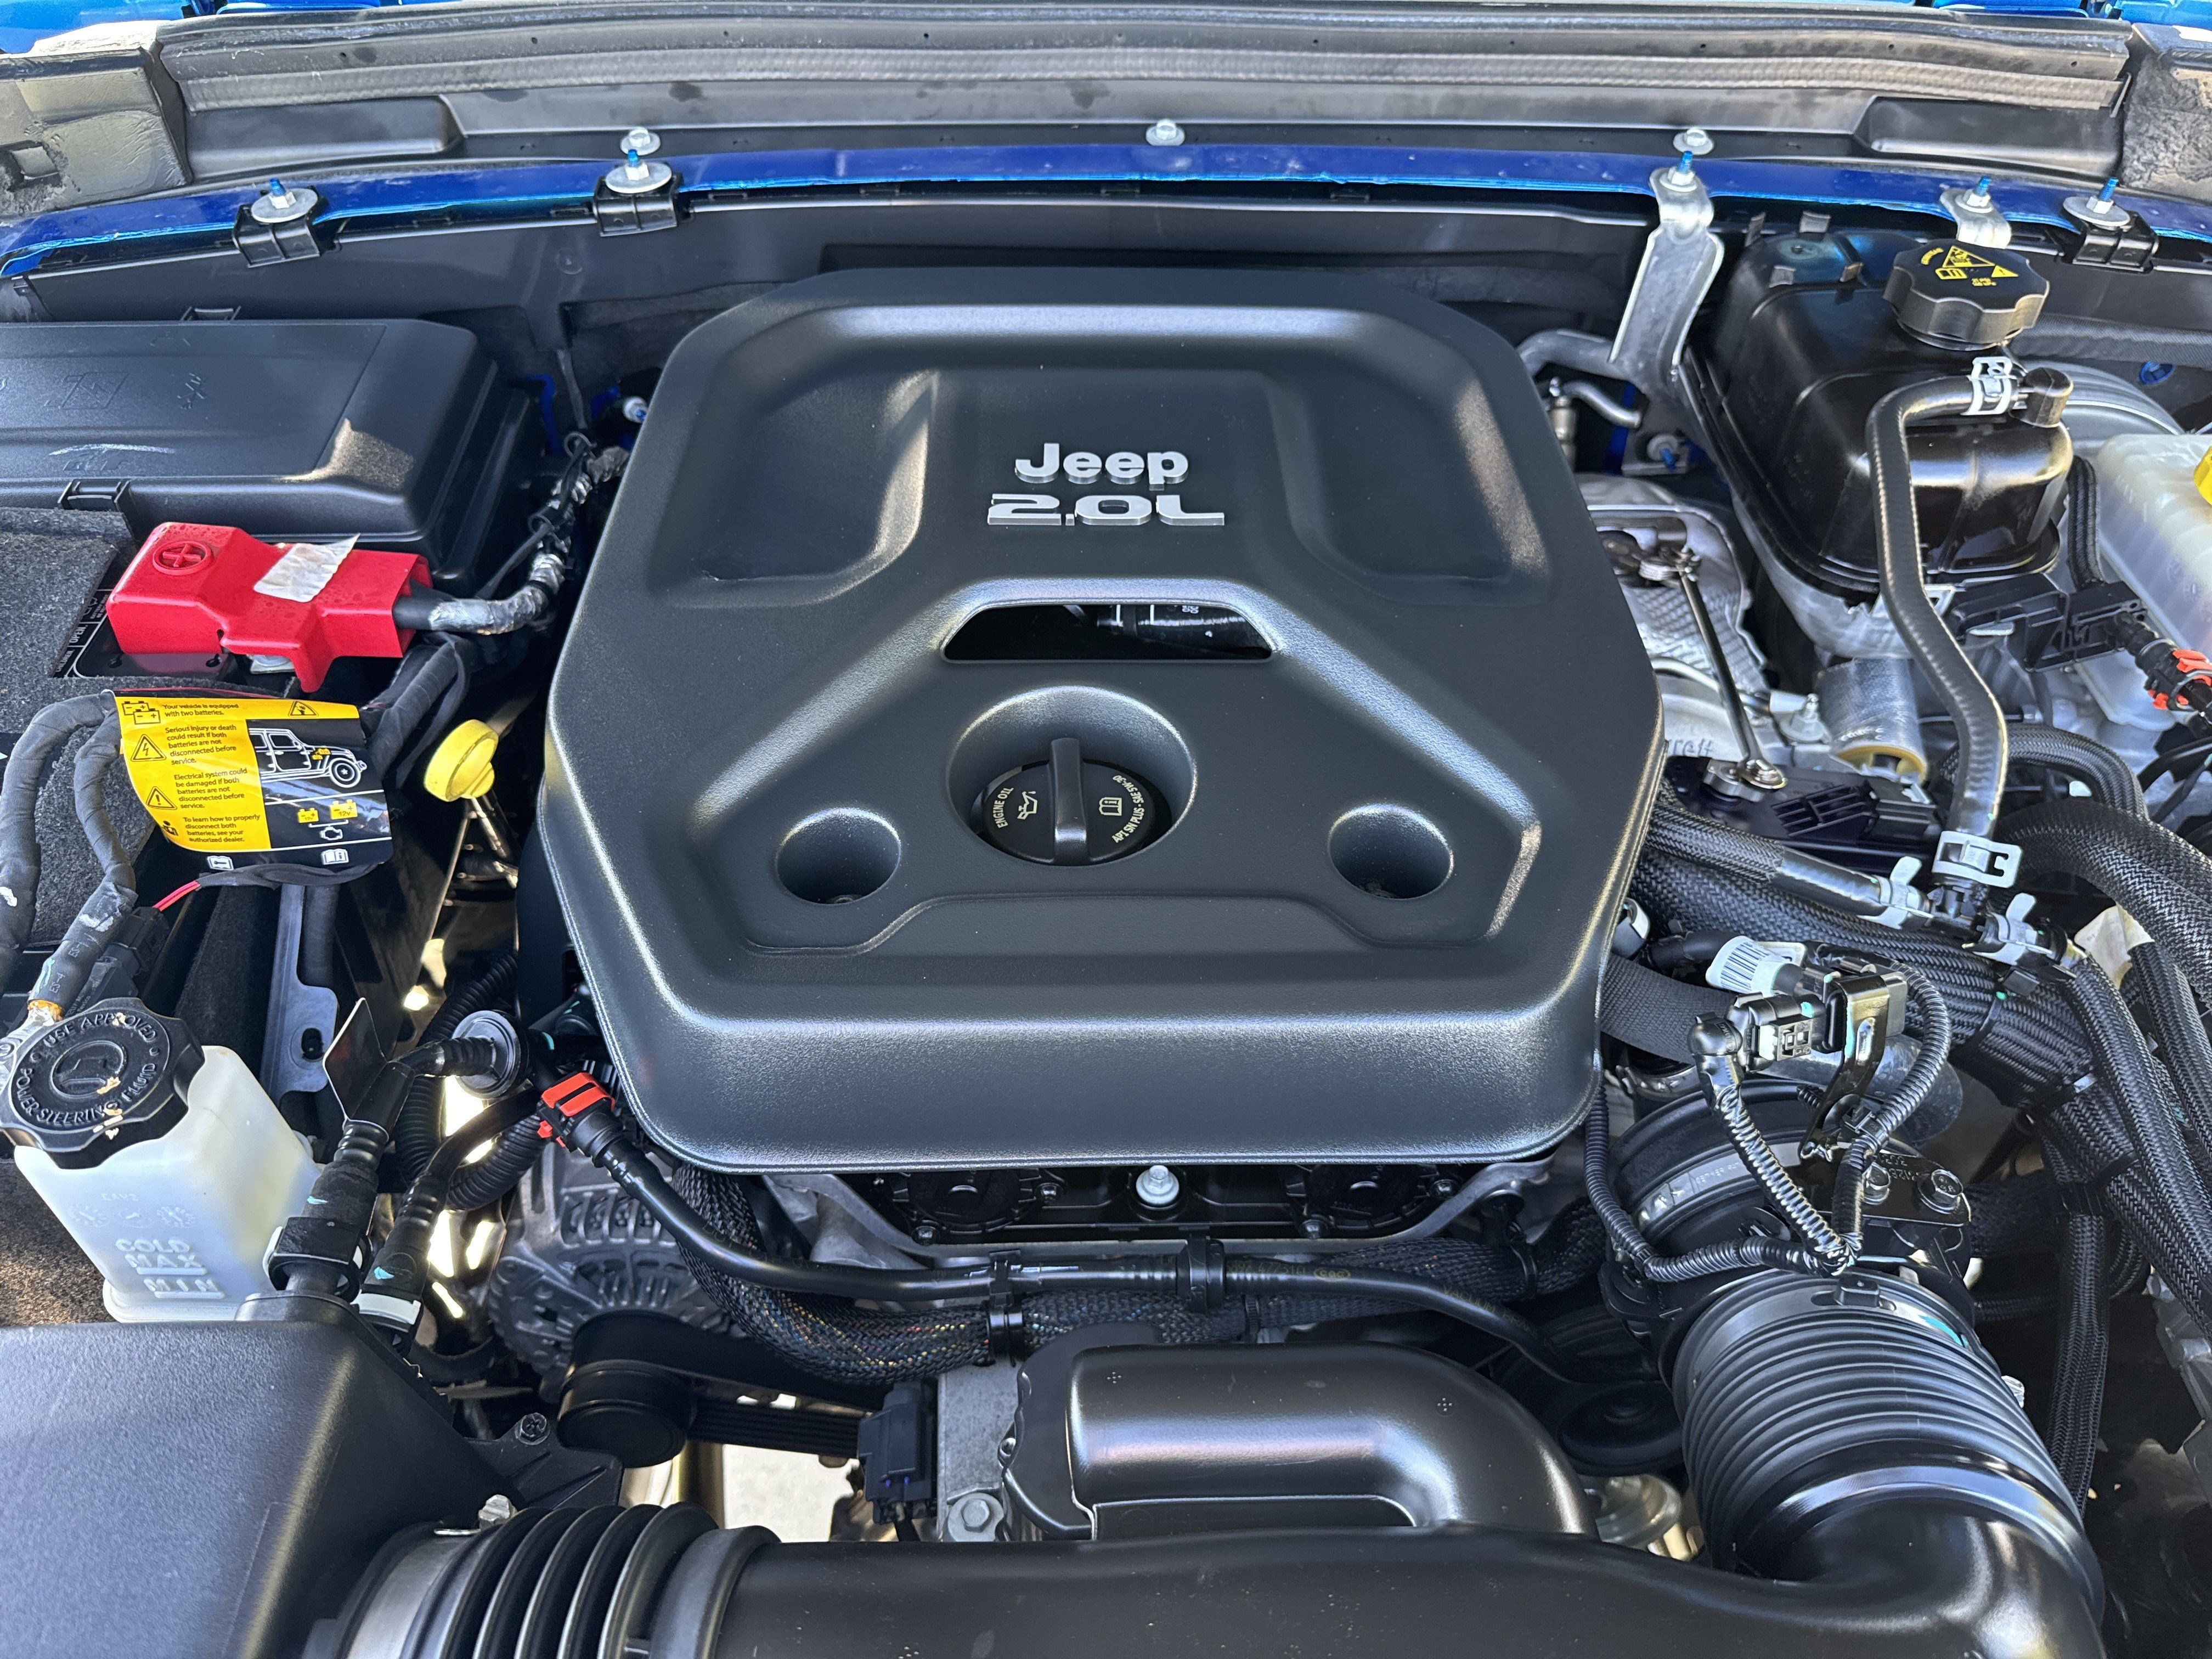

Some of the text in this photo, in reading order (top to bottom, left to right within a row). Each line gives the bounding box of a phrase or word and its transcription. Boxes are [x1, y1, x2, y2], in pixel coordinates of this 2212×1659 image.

[1014, 443, 1189, 491] Jeep
[988, 493, 1225, 526] 2.0L
[165, 725, 190, 733] Serious
[168, 741, 198, 749] batteries
[170, 747, 215, 757] disconnected
[174, 772, 204, 780] Electrical
[205, 770, 228, 779] system
[992, 787, 1014, 828] ENGINE OIL
[1111, 775, 1145, 843] API SN PLUS SAE 5W-30
[233, 814, 260, 822] properly
[43, 1023, 75, 1048] USE
[16, 1063, 156, 1126] POWER STEERING FLUID
[115, 1238, 190, 1254] COLD
[125, 1254, 203, 1268] MAX
[143, 1278, 218, 1293] MIN
